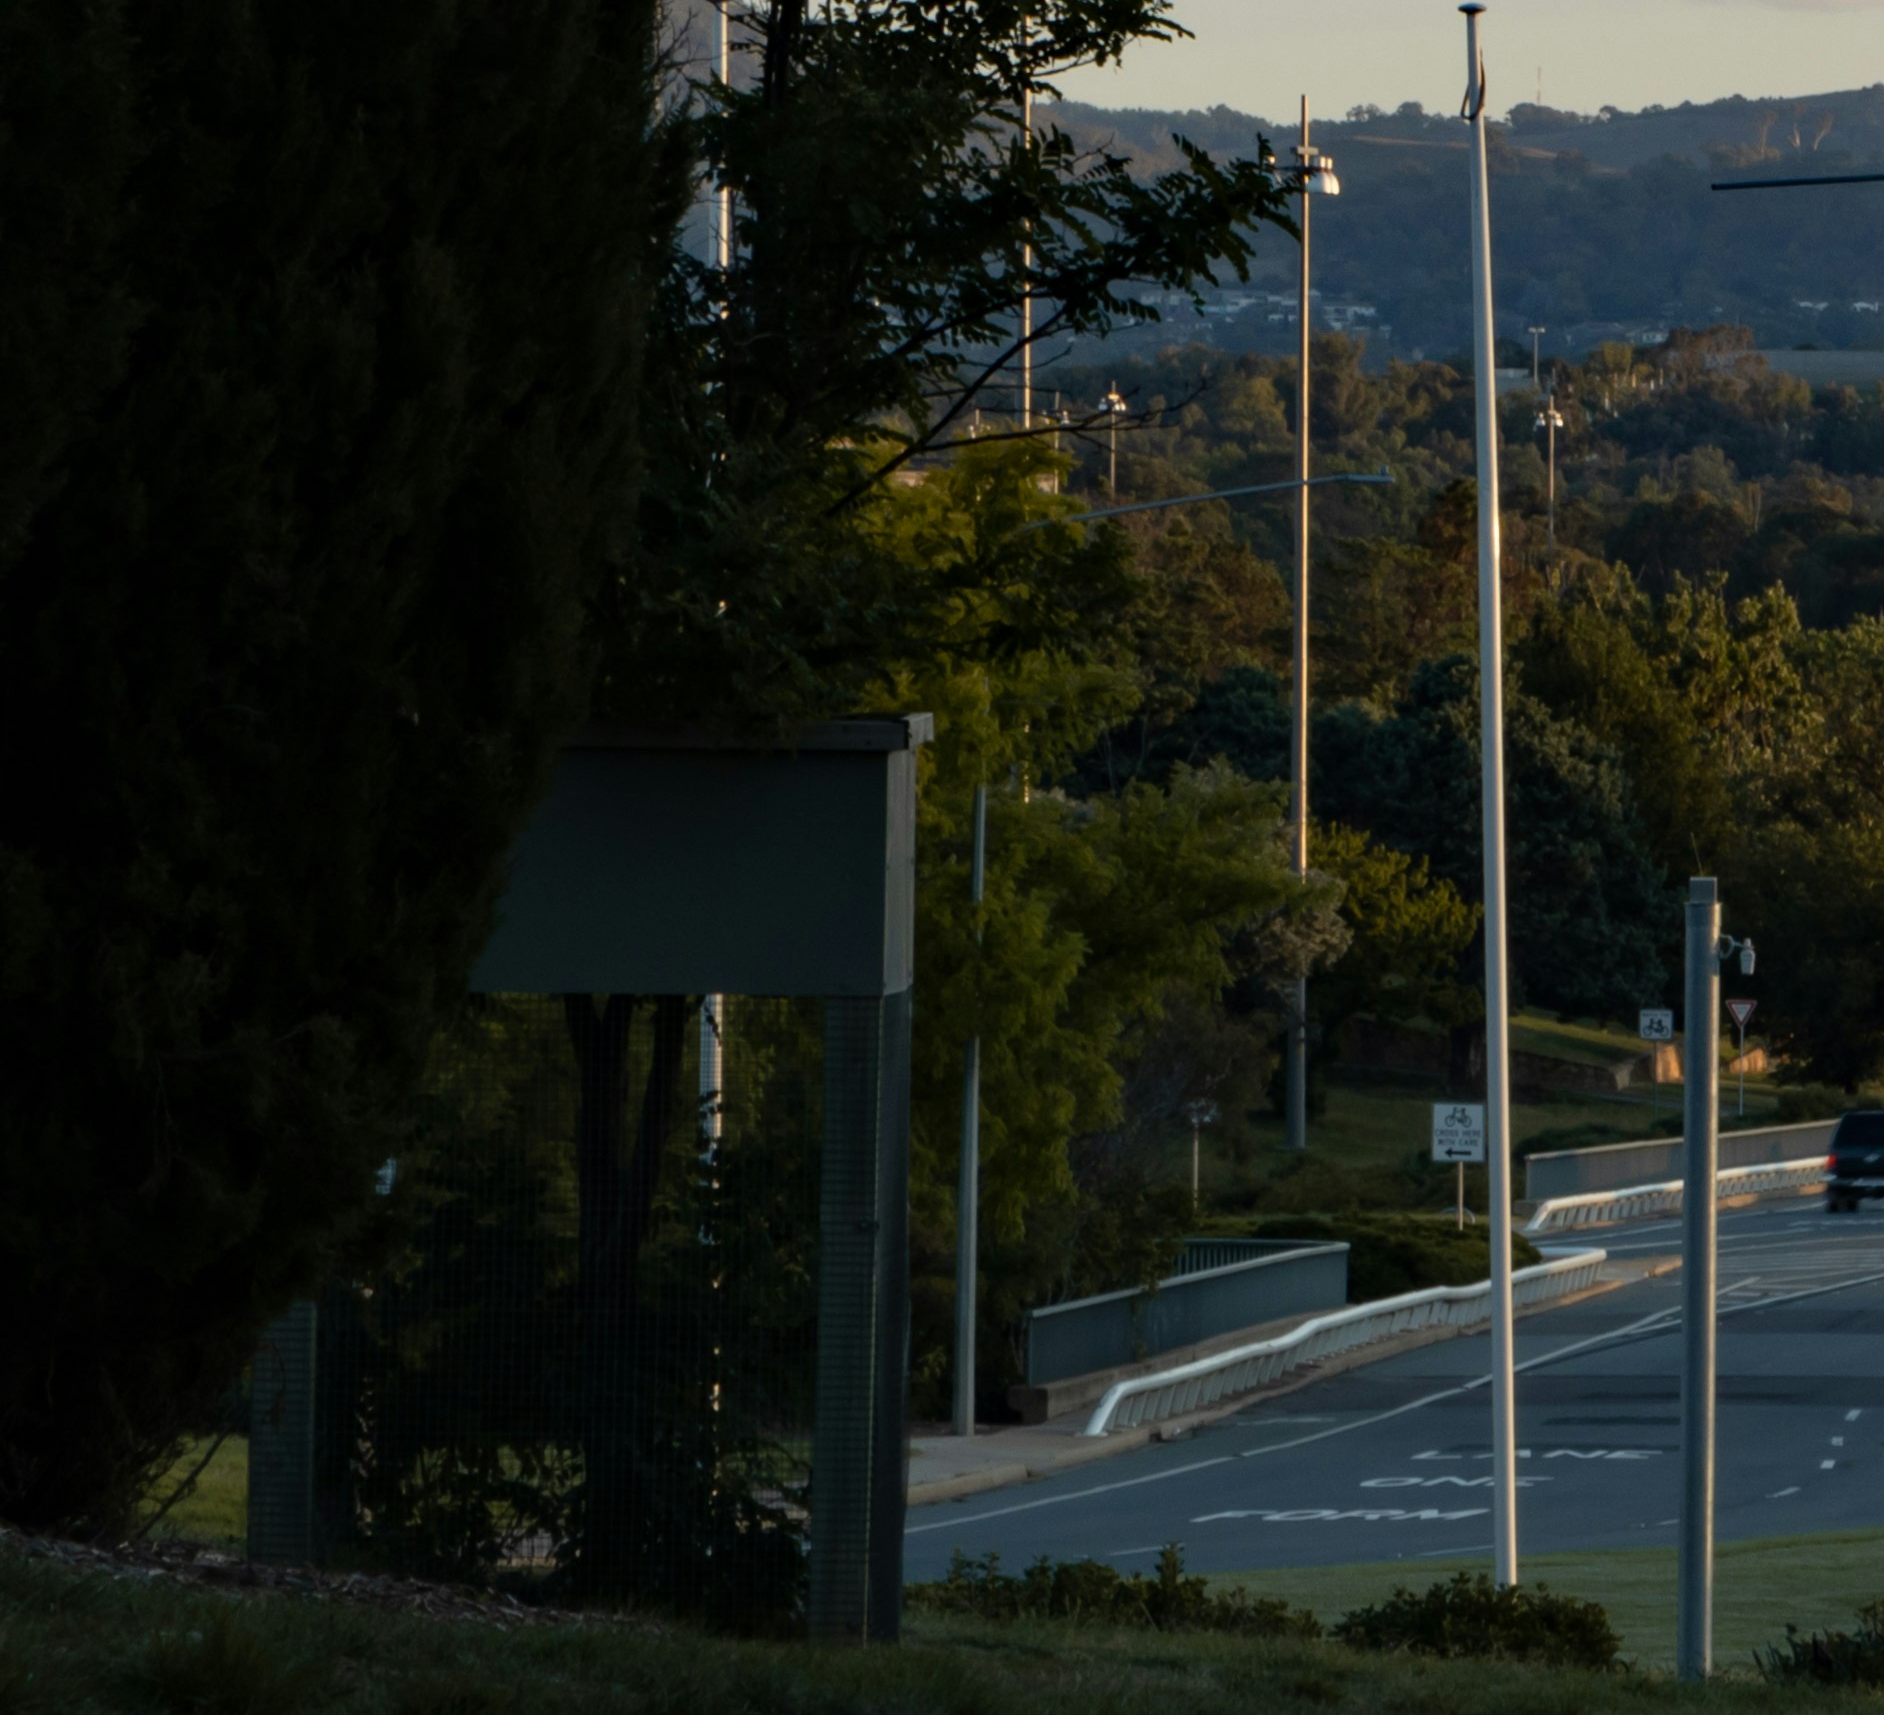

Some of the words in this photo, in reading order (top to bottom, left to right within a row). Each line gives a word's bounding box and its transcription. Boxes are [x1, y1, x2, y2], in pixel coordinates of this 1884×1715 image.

[1410, 1449, 1664, 1460] LANE
[1360, 1476, 1554, 1487] ONE
[1190, 1509, 1491, 1523] FORM
